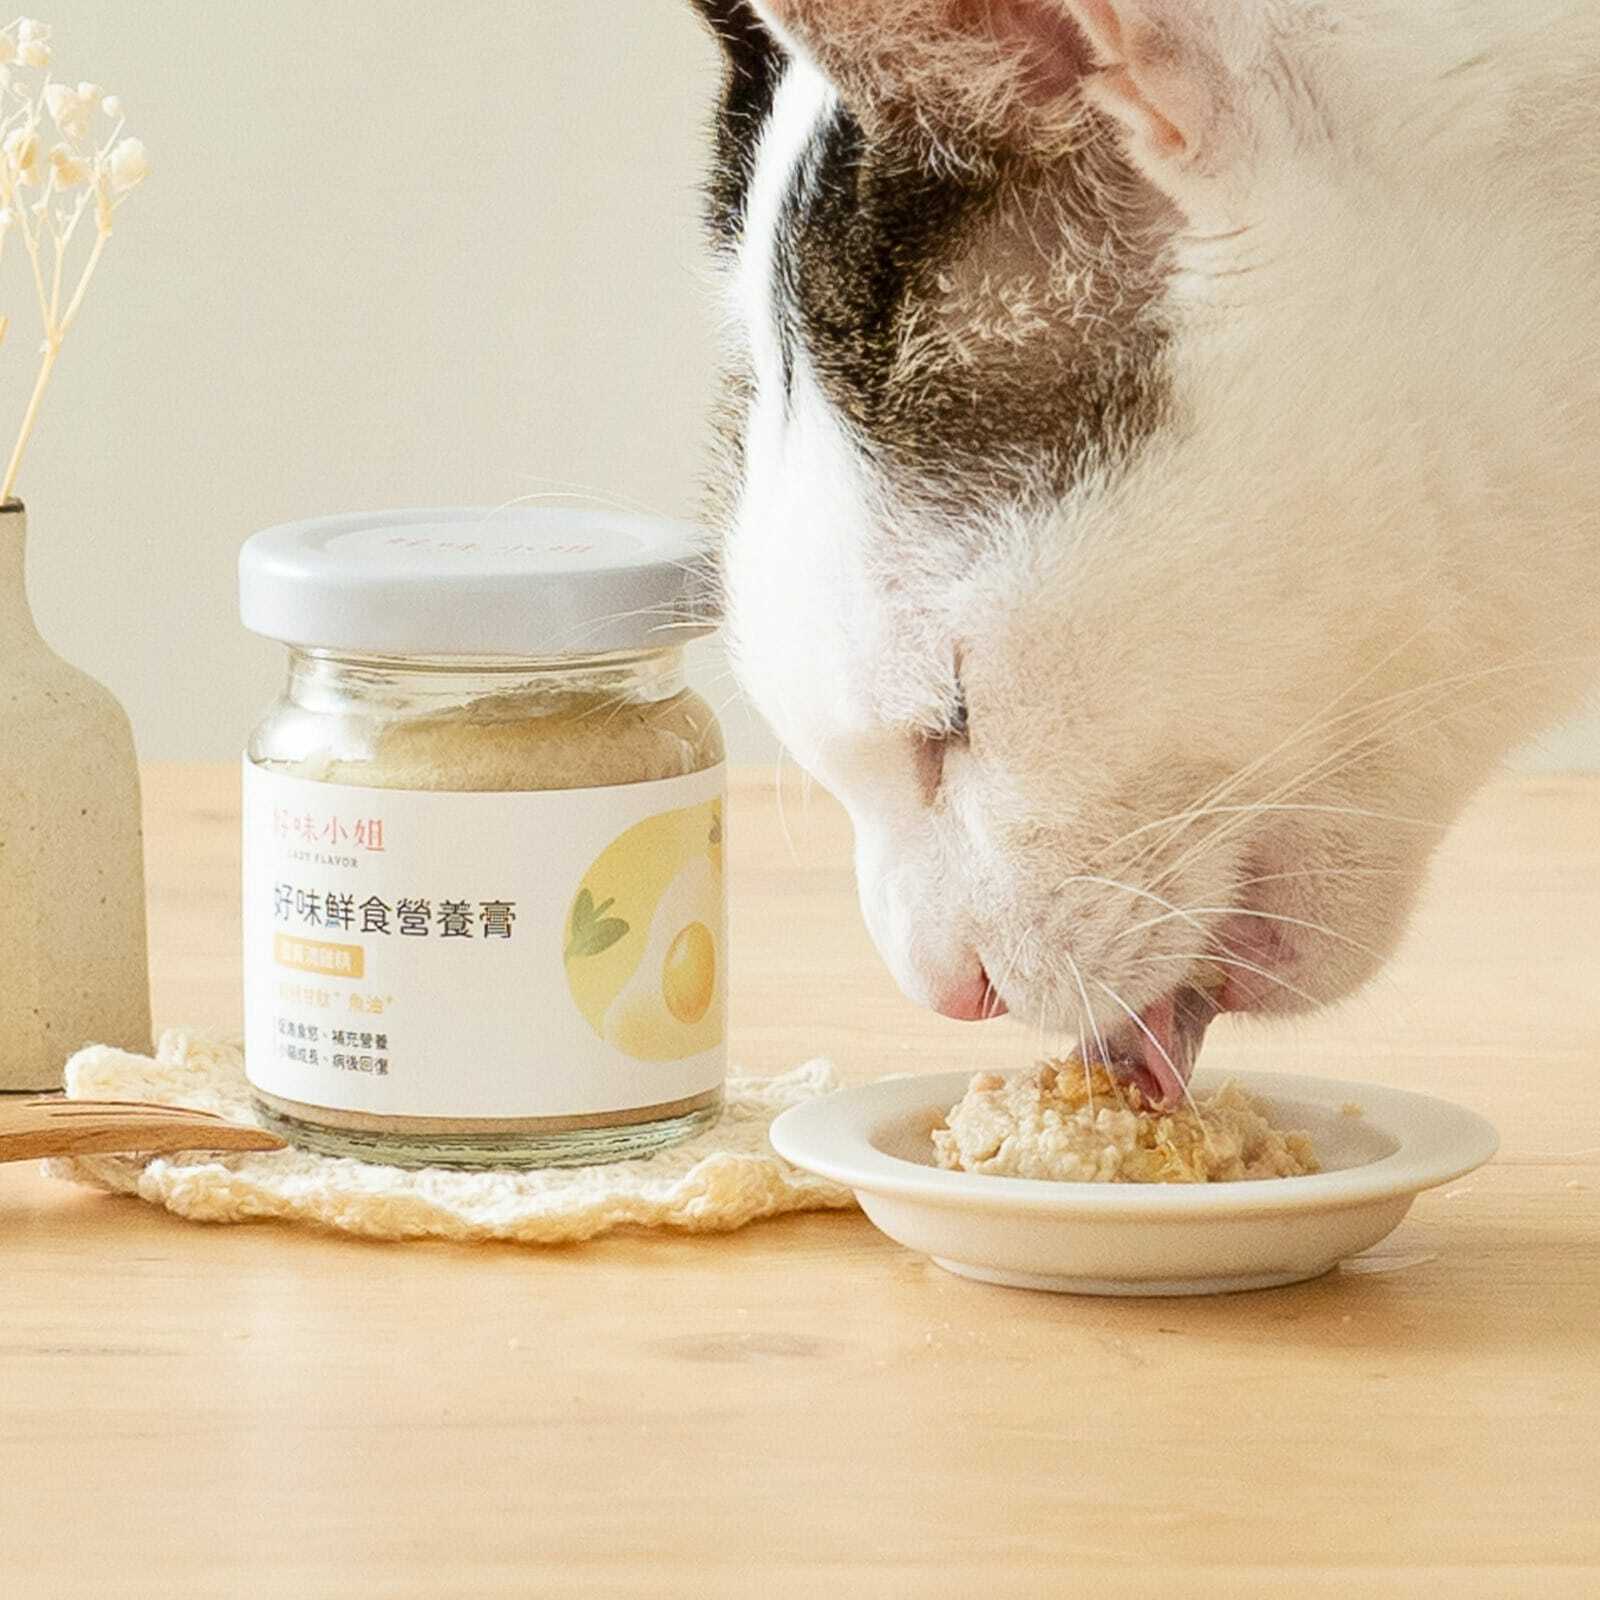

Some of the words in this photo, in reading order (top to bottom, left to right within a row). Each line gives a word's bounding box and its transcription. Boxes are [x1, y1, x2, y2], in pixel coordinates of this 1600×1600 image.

[273, 883, 518, 939] 好味鮮食營養膏
